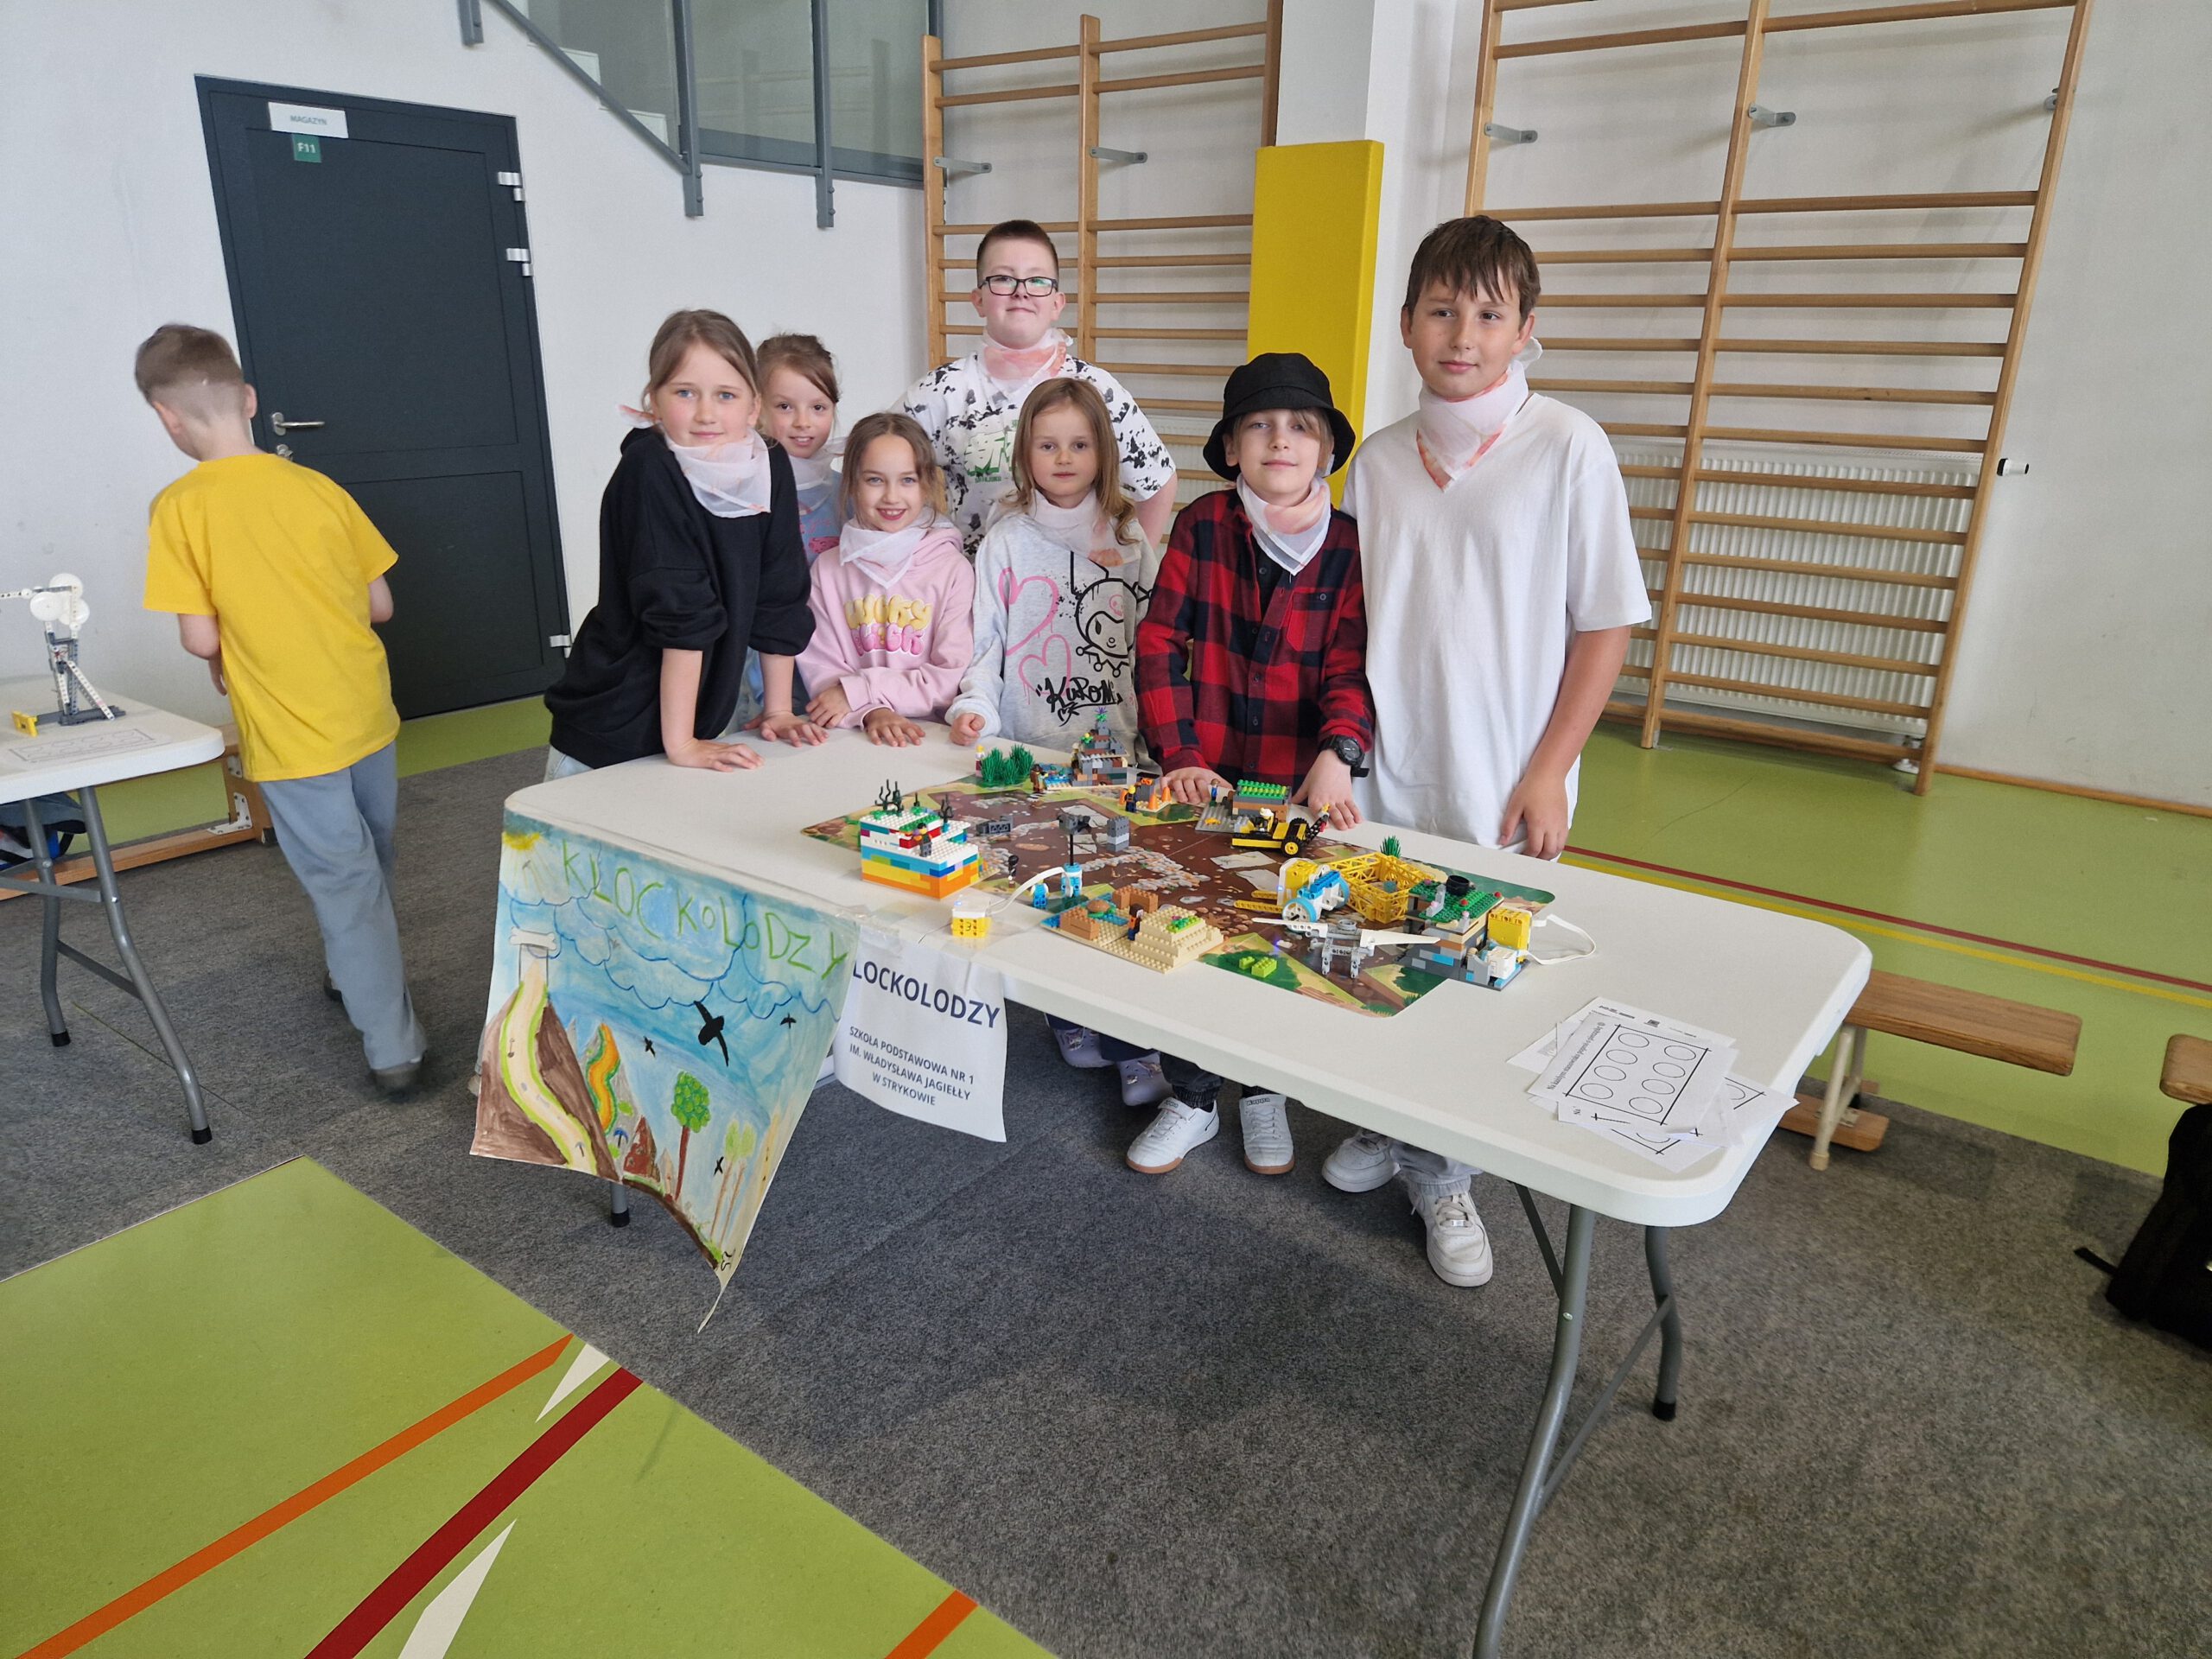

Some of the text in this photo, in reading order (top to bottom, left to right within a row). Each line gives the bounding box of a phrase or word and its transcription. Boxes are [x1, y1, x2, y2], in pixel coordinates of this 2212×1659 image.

[289, 115, 327, 125] MAGAZYN
[297, 143, 316, 154] F11
[849, 1026, 974, 1084] SZKOŁA PODSTAWOWA NR 1
[849, 1043, 971, 1101] IM. WŁADYSŁAWA JAGIEŁŁY
[872, 1071, 936, 1105] W STRYKOWIE
